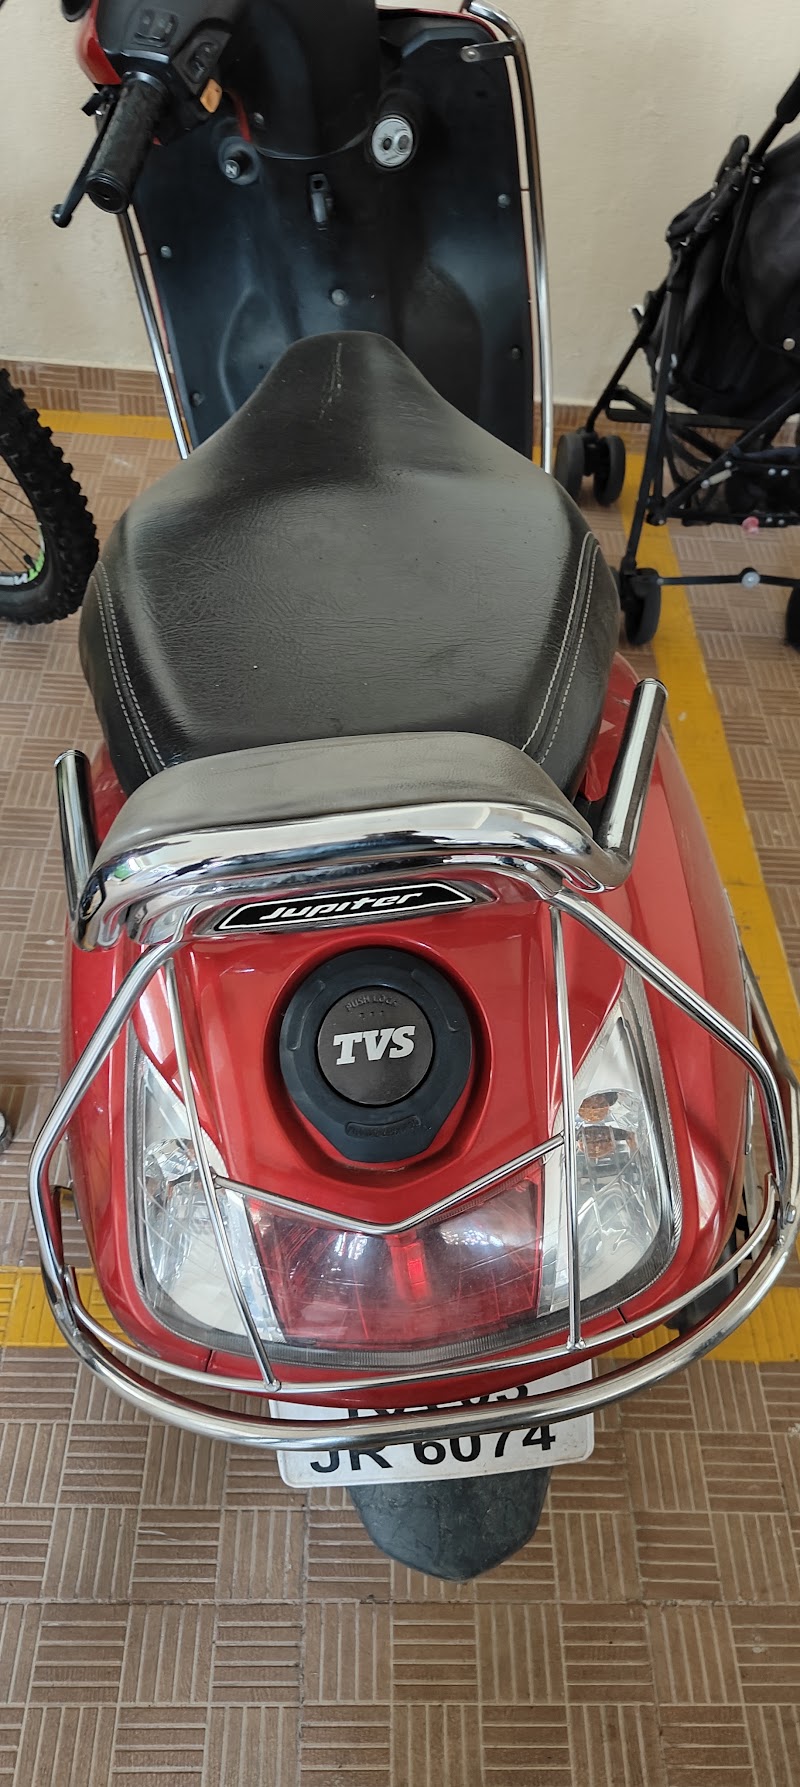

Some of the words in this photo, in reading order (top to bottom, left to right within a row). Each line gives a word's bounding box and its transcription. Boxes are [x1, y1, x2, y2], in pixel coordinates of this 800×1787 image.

[345, 994, 371, 1012] PUSH
[332, 1025, 416, 1066] TVS
[310, 1447, 393, 1474] JR
[412, 1424, 556, 1466] 6074
